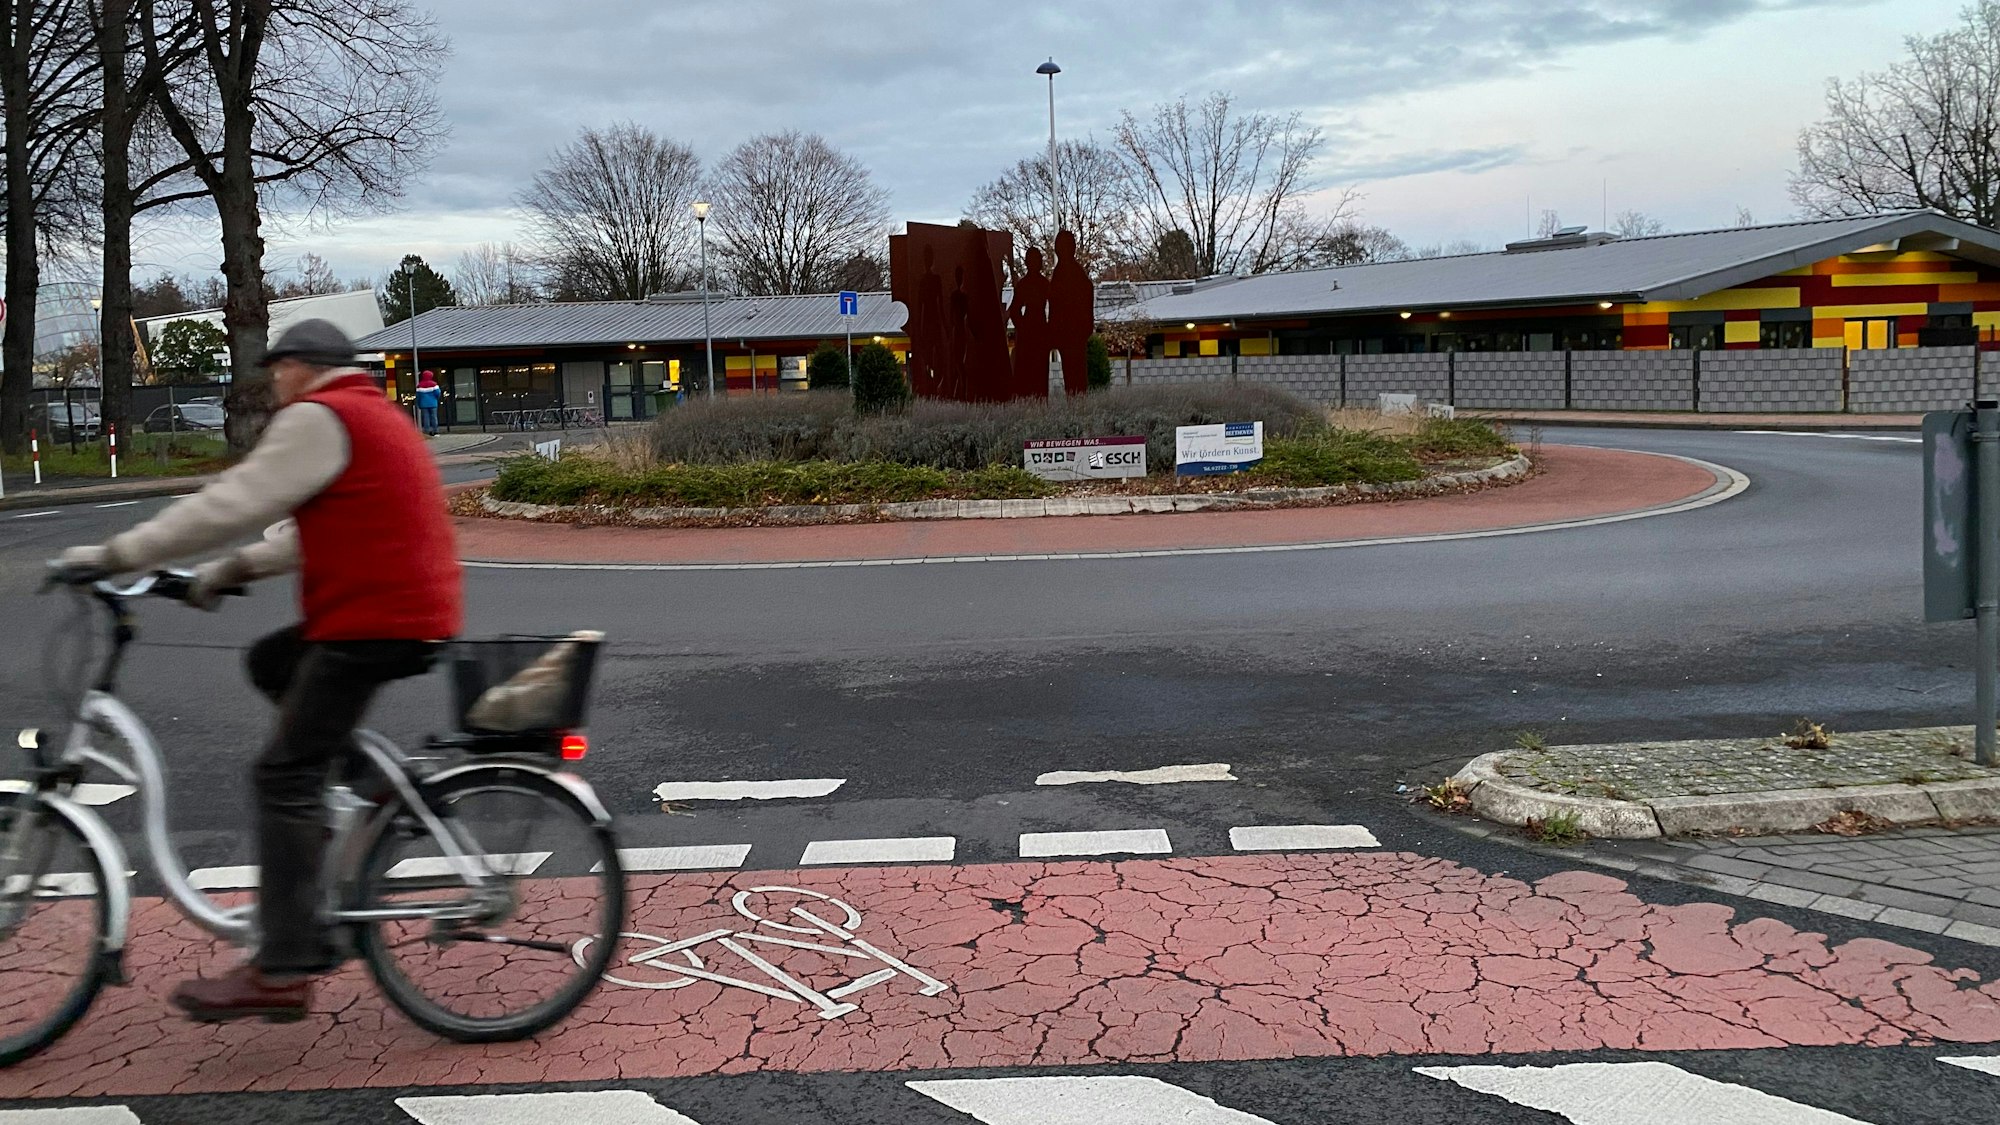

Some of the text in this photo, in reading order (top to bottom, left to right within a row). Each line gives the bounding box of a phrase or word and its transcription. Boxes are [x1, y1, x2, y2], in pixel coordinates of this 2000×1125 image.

[1106, 452, 1141, 464] ESCH
[1182, 450, 1197, 458] Wir
[1233, 446, 1259, 455] Kunst.
